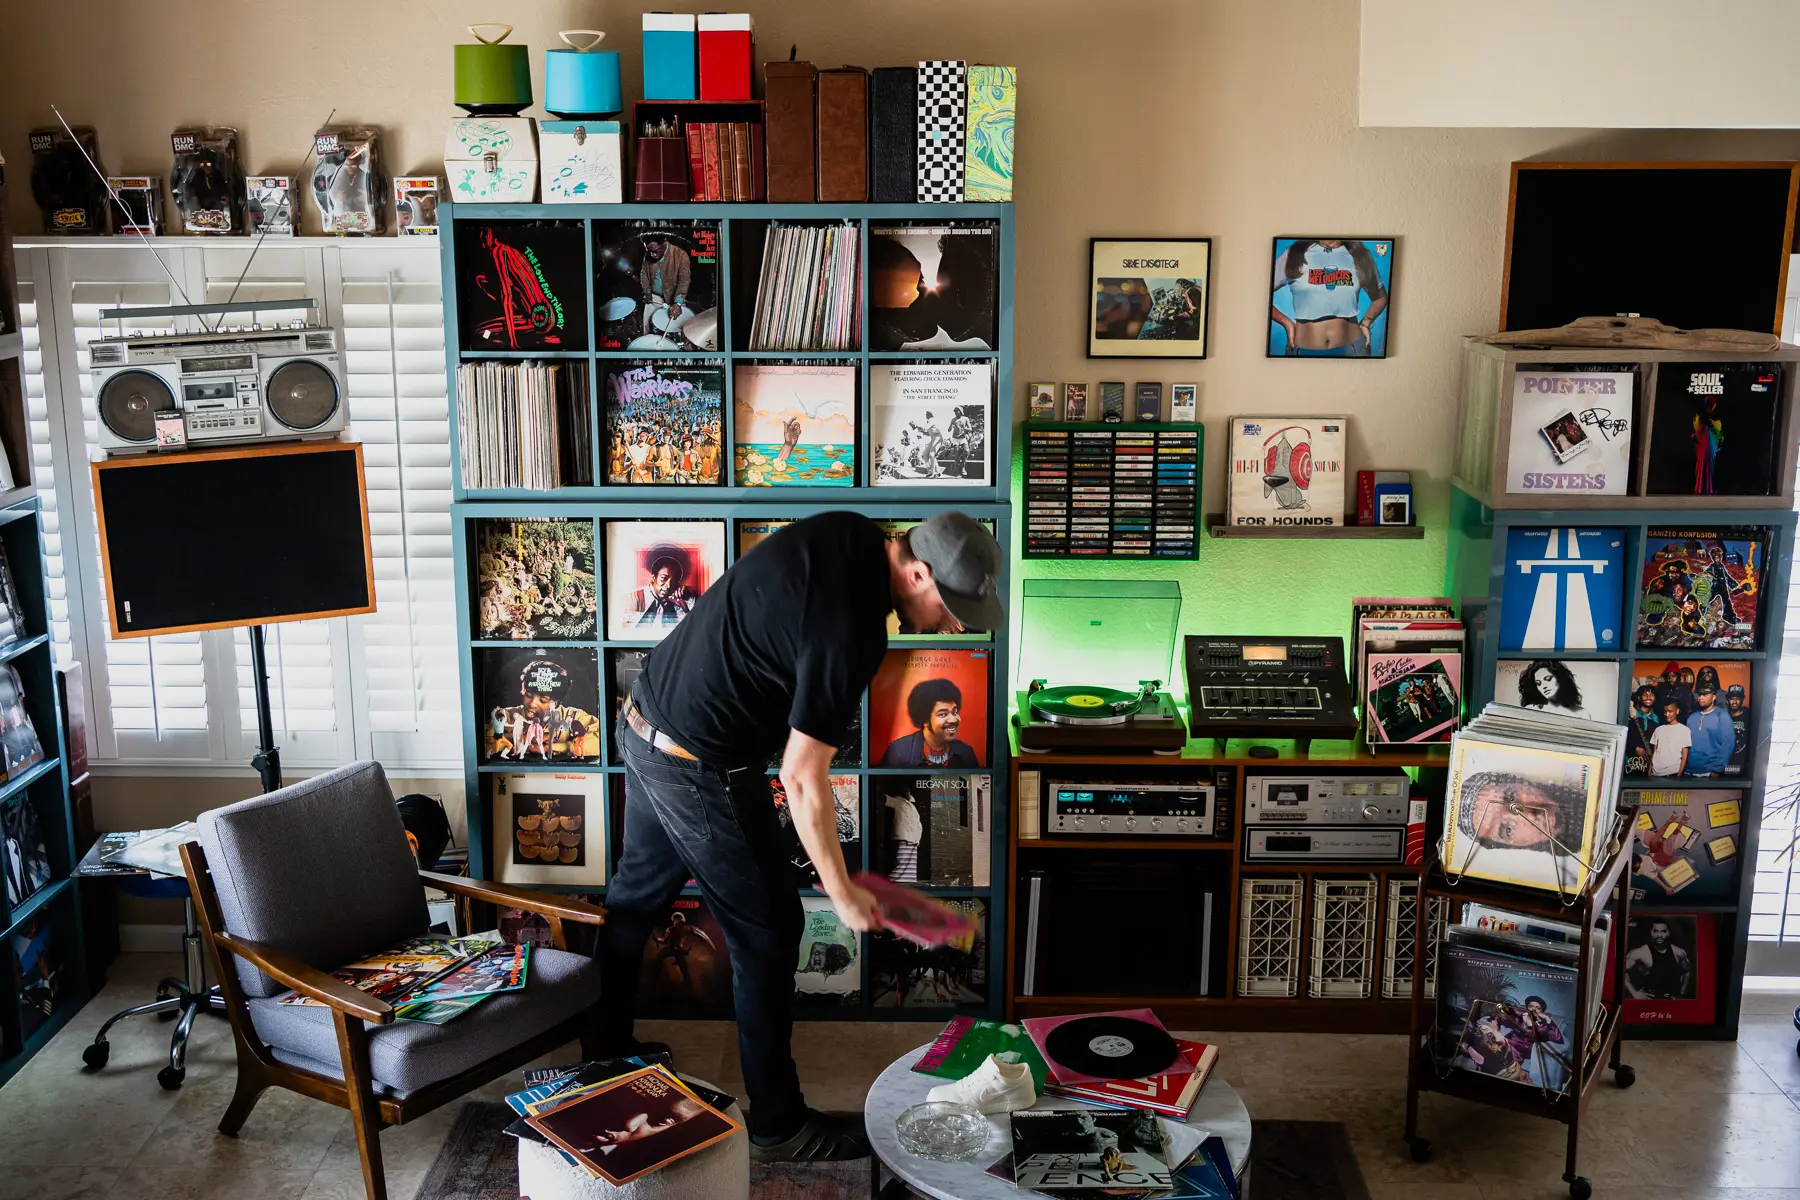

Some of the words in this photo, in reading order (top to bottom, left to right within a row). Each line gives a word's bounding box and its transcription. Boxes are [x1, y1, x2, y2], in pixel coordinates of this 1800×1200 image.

[32, 135, 51, 144] RUN
[173, 136, 194, 145] RUN
[316, 136, 337, 146] RUN
[33, 142, 52, 151] DMC
[175, 143, 195, 151] DMC
[318, 144, 339, 152] DMC
[1140, 258, 1179, 269] DISCOTECA
[1308, 268, 1324, 276] LOS
[1308, 269, 1353, 285] MELODICOS
[524, 246, 539, 264] THE
[533, 263, 545, 283] LOW
[541, 282, 553, 300] END
[550, 296, 565, 330] THEORY
[623, 365, 656, 381] THE
[1690, 372, 1721, 386] SOUL
[1523, 377, 1617, 395] POINTER
[1694, 385, 1724, 395] SELLER
[1236, 459, 1259, 473] HI-FI
[1314, 461, 1341, 472] SOUNDS
[1523, 472, 1606, 490] SISTERS
[1237, 517, 1266, 525] FOR
[1272, 516, 1334, 526] HOUNDS
[741, 524, 769, 534] kool
[1678, 531, 1717, 539] KONFUSION
[1371, 659, 1396, 680] Rufus
[1627, 757, 1644, 767] EGO
[915, 779, 950, 789] ELEGANT
[950, 780, 970, 789] SOUL
[1640, 791, 1667, 805] PRIME
[1669, 791, 1689, 805] TIME
[812, 917, 825, 925] The
[809, 923, 838, 932] Loading
[1639, 1011, 1657, 1019] OOH
